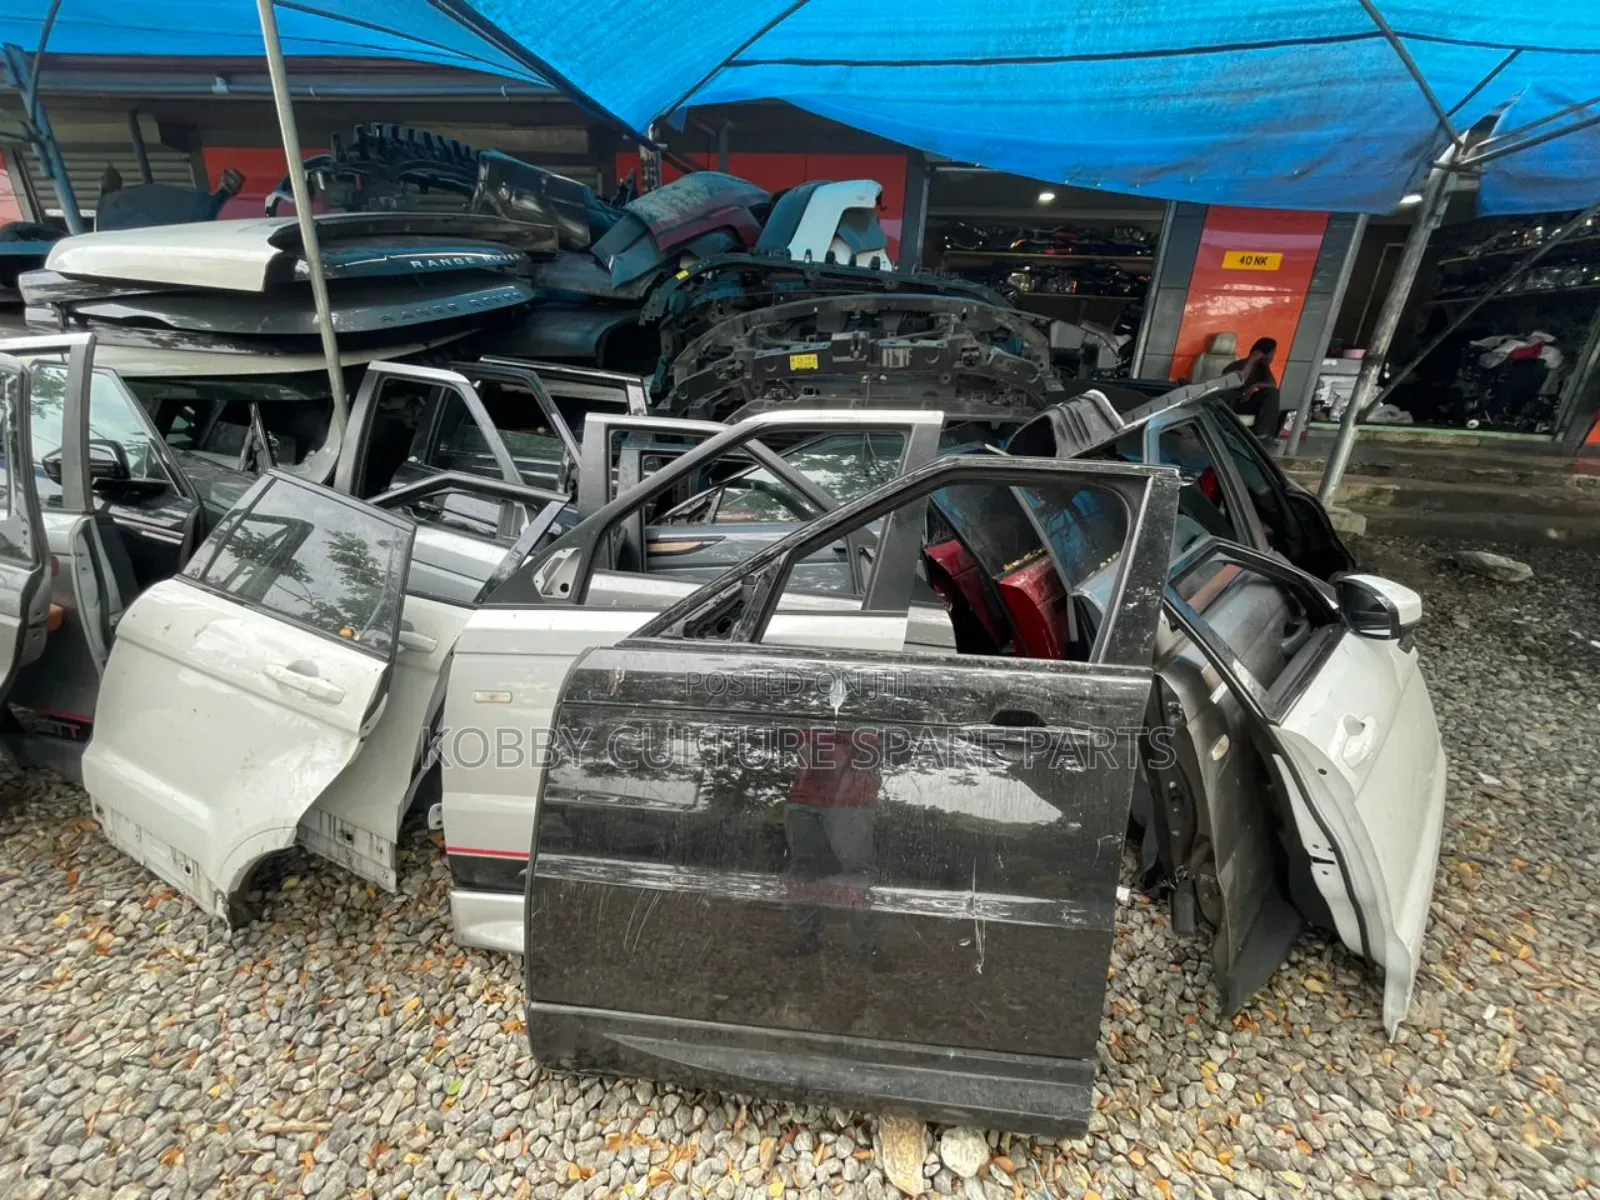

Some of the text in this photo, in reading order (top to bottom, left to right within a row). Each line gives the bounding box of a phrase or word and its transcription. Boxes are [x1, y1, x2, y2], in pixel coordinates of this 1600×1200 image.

[410, 256, 476, 269] RANGE
[1240, 256, 1269, 265] 40 NK
